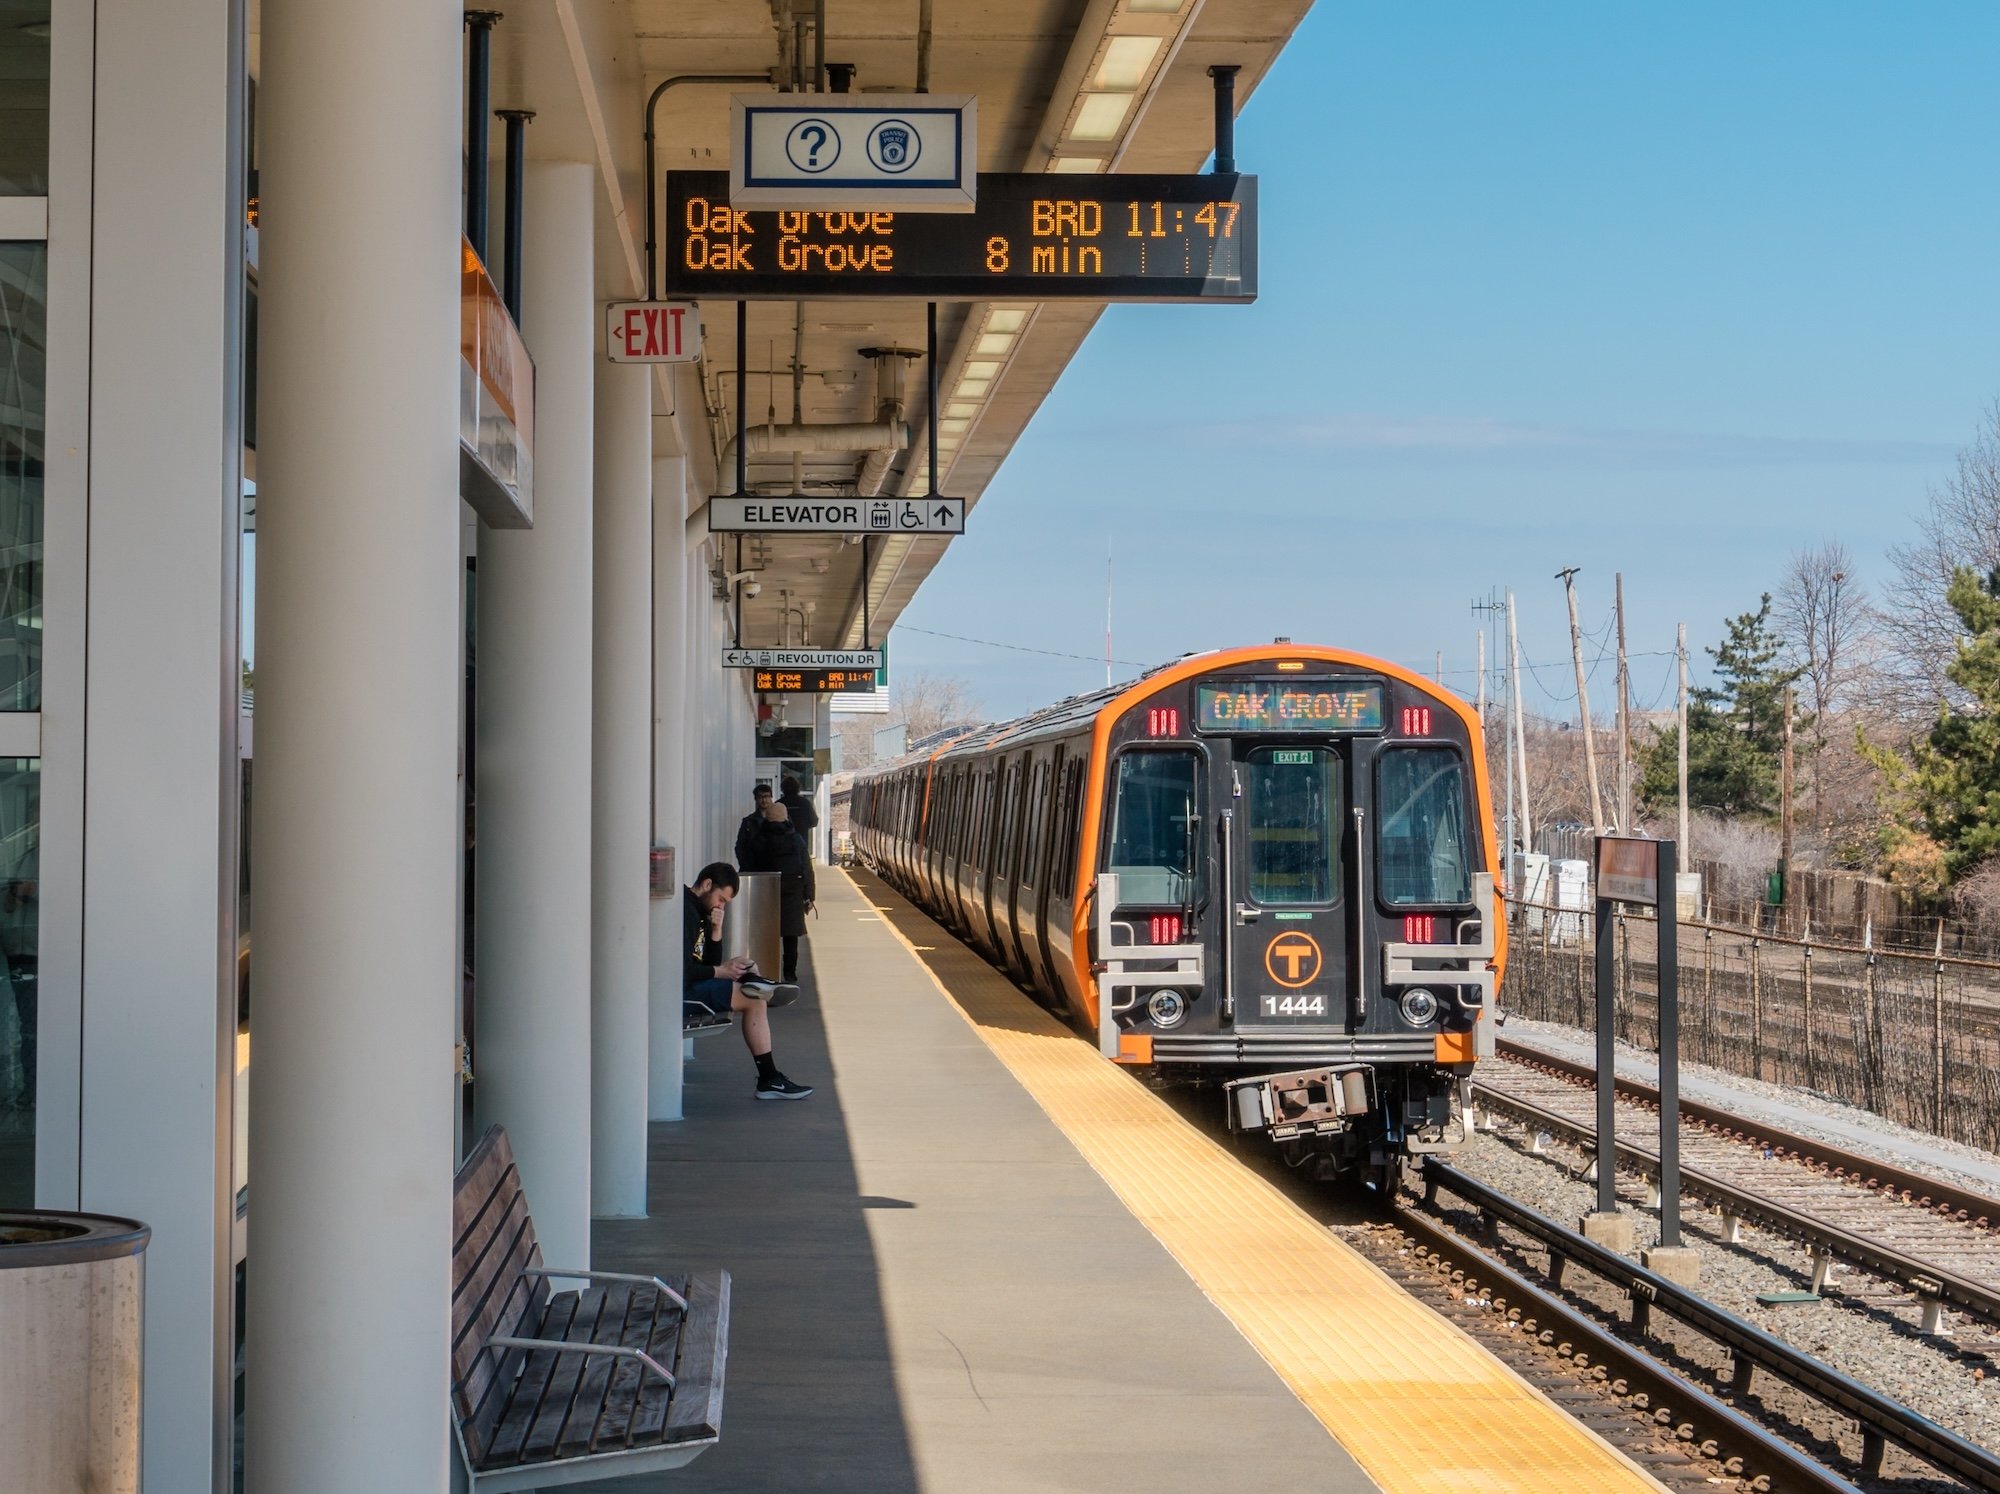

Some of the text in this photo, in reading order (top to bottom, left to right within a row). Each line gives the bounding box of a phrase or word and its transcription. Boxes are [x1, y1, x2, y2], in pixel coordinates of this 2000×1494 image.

[686, 198, 1240, 238] Oak Grove BRD 11:47
[686, 233, 1102, 273] Oak Grove 8 min
[625, 308, 686, 356] EXIT
[744, 506, 858, 523] ELEVATOR
[777, 654, 875, 664] REVOLUTION DR
[757, 673, 772, 681] Oak
[776, 673, 801, 681] Grove
[848, 673, 873, 681] 11:47
[757, 680, 772, 688] Oak
[776, 680, 801, 688] Grove
[819, 680, 826, 688] 8
[1214, 692, 1367, 719] OAK GROVE
[1278, 752, 1297, 762] EXIT
[1275, 945, 1312, 978] T
[1265, 996, 1325, 1015] 1444
